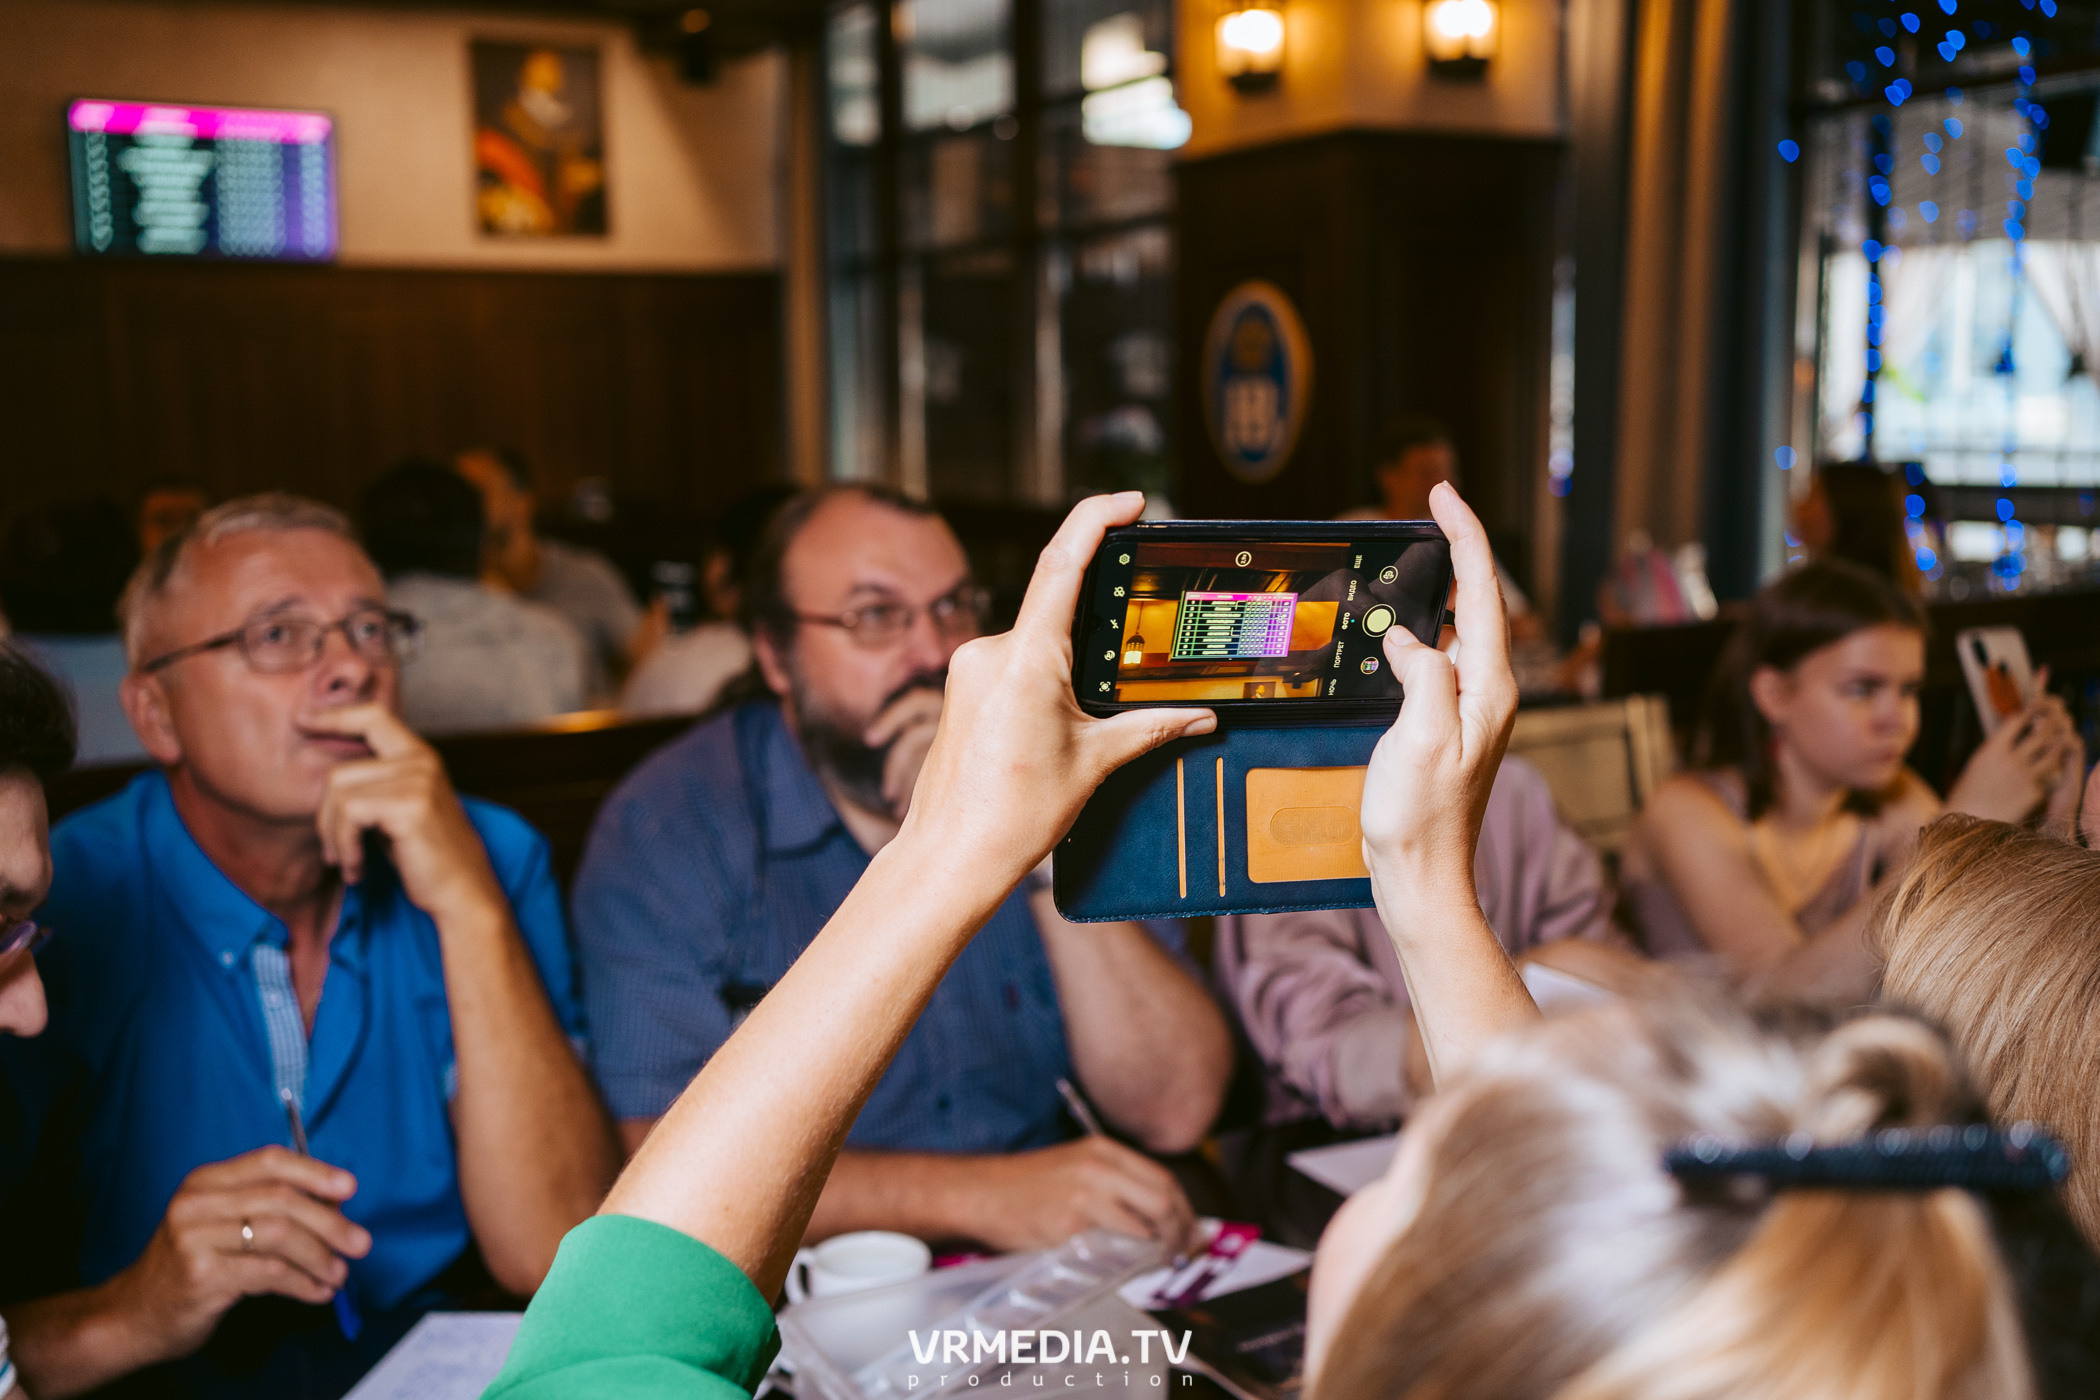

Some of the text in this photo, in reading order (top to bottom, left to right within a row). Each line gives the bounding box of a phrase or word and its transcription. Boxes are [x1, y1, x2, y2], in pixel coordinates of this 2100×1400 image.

[1333, 641, 1345, 668] ПОРТРЕТ
[1341, 612, 1351, 630] ФОТО
[1347, 580, 1357, 601] ВИДЕО
